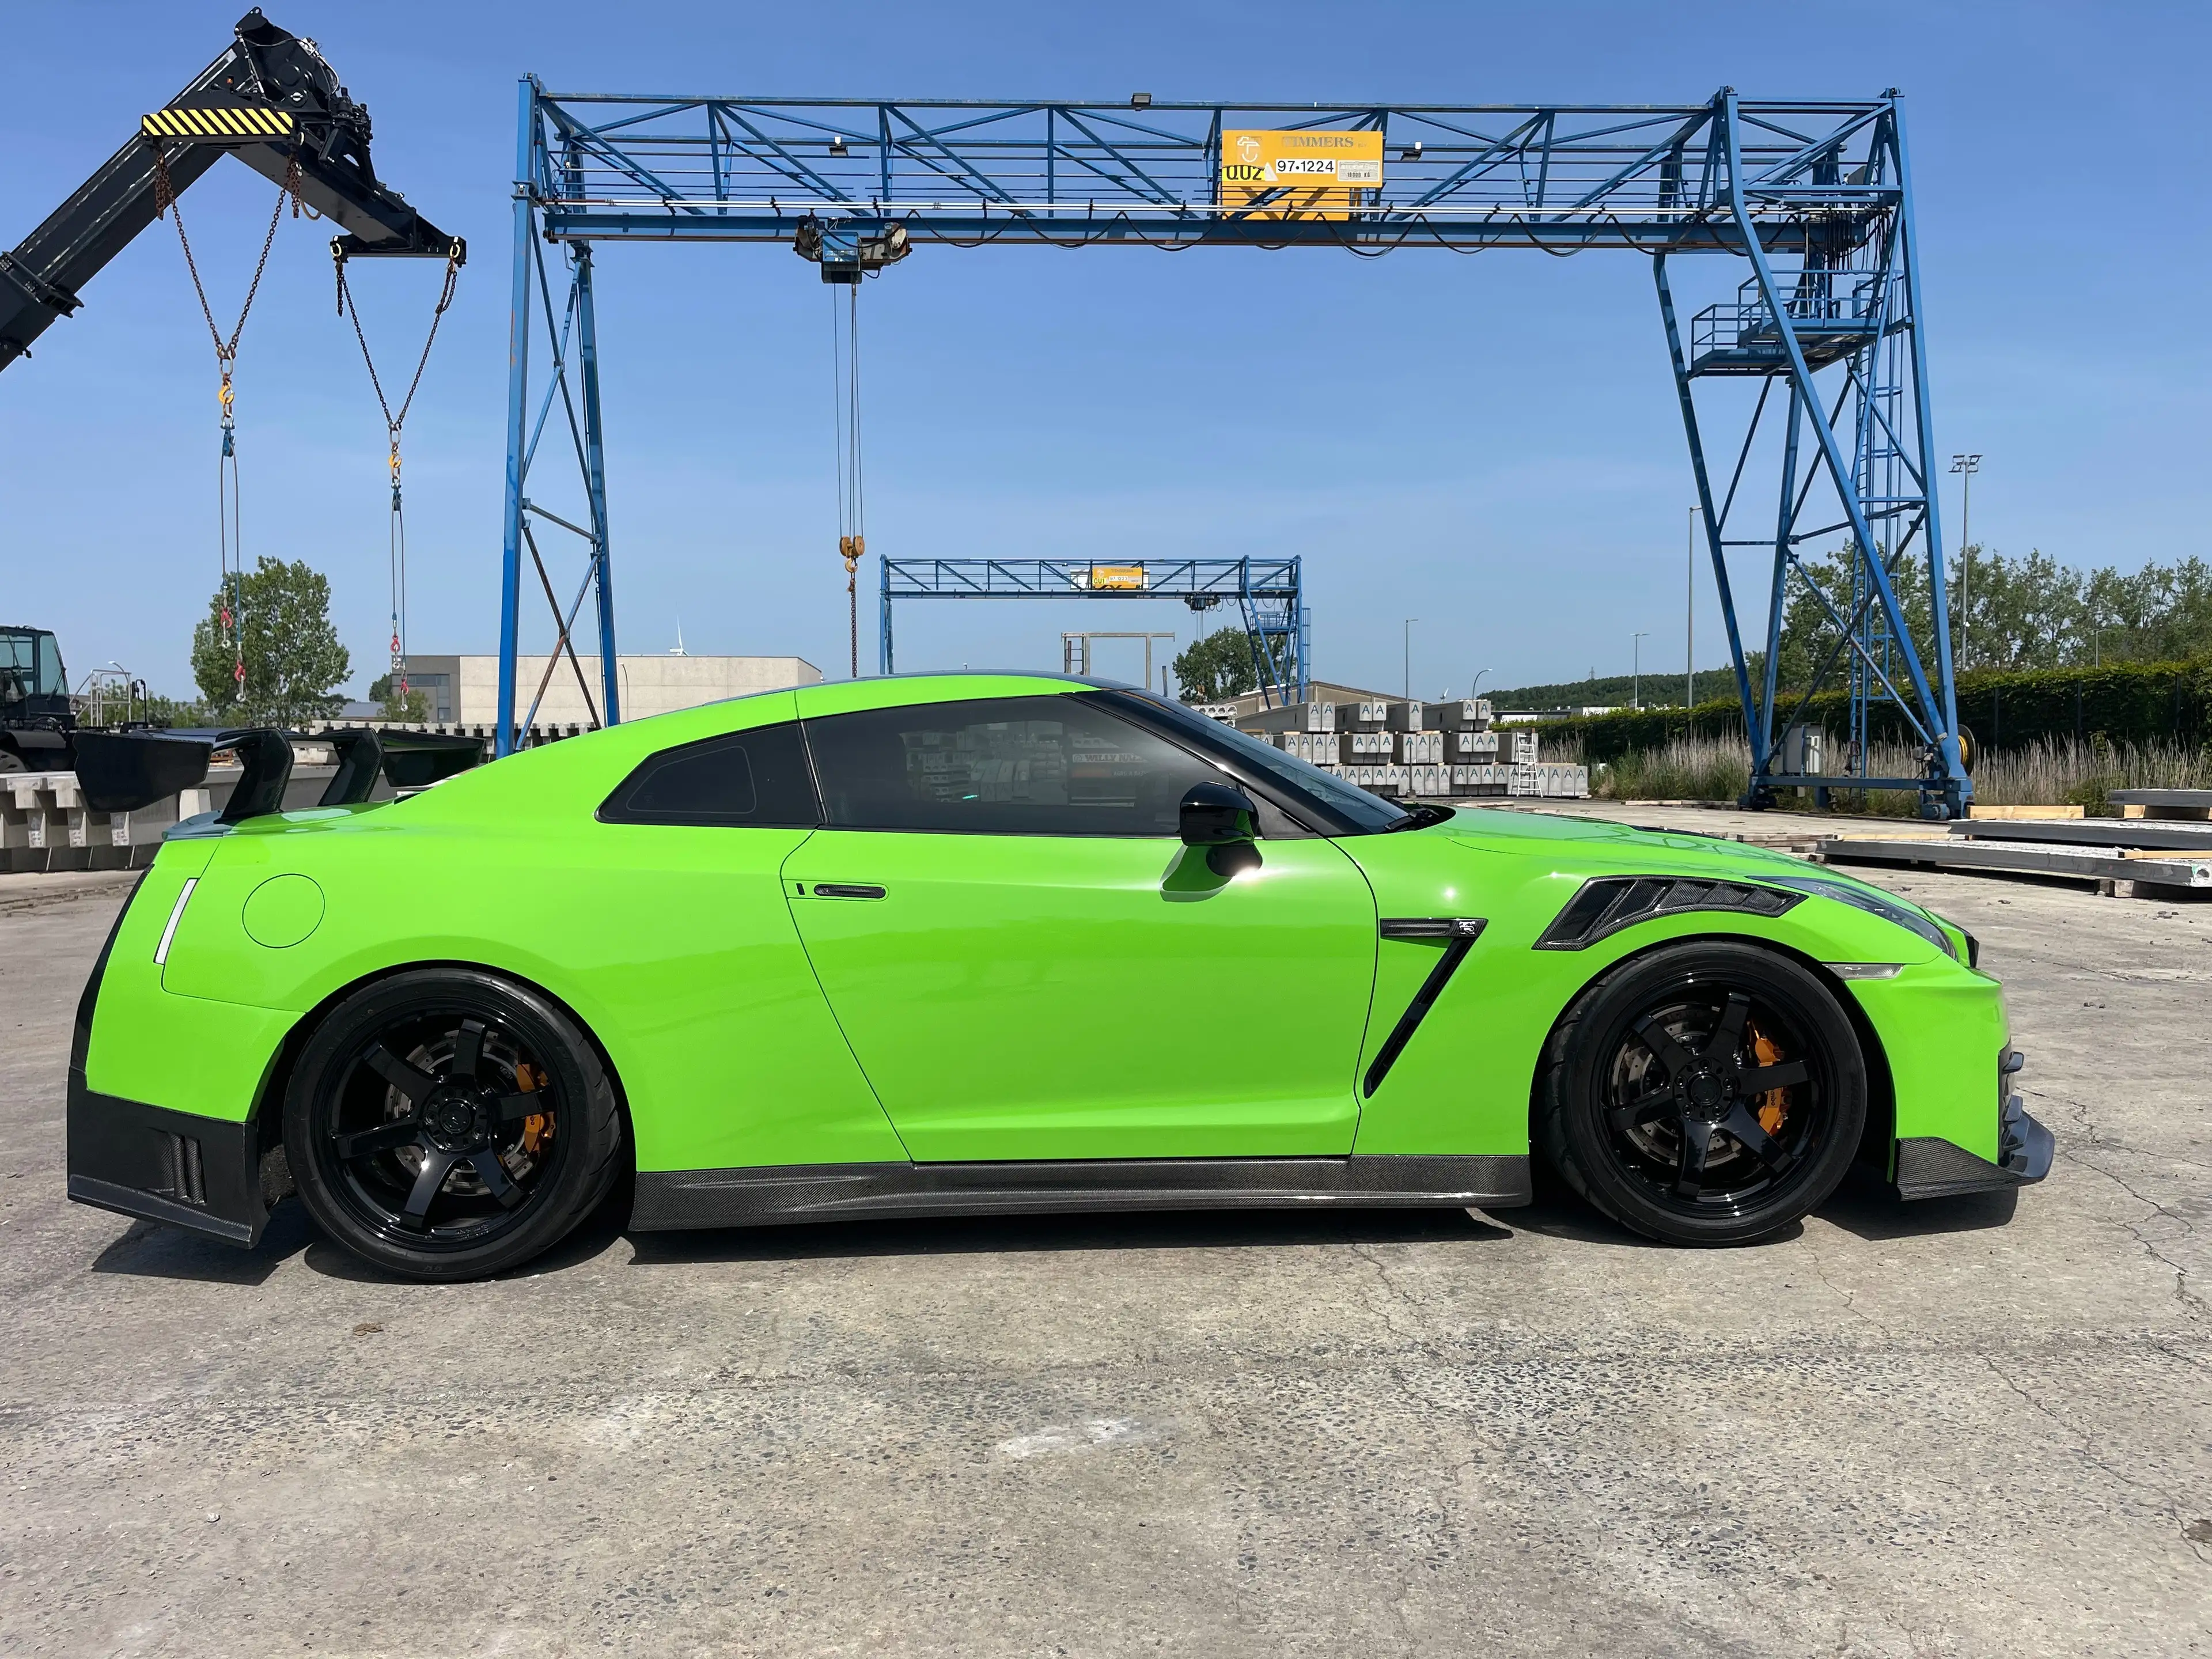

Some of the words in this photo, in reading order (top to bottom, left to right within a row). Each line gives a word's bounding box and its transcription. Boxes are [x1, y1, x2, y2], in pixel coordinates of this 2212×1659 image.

[1310, 704, 1319, 714] A
[1325, 704, 1333, 714] A
[1362, 704, 1371, 714] A
[1376, 704, 1384, 714] A
[1411, 704, 1419, 713] A
[1465, 704, 1473, 713] A
[1480, 704, 1488, 713] A
[1288, 737, 1296, 746] A
[1302, 737, 1310, 746] A
[1316, 737, 1324, 746] A
[1329, 737, 1337, 746] A
[1355, 737, 1363, 746] A
[1369, 737, 1377, 746] A
[1383, 736, 1391, 745] A
[1406, 736, 1414, 745] A
[1419, 736, 1427, 745] A
[1433, 736, 1441, 745] A
[1463, 736, 1470, 745] A
[1476, 736, 1484, 745] A
[1488, 736, 1495, 745] A
[1349, 770, 1356, 778] A
[1362, 769, 1370, 778] A
[1376, 769, 1384, 778] A
[1389, 769, 1397, 778] A
[1401, 769, 1408, 778] A
[1414, 768, 1422, 777] A
[1427, 768, 1434, 777] A
[1441, 768, 1449, 777] A
[1457, 768, 1464, 777] A
[1470, 768, 1478, 777] A
[1484, 768, 1491, 777] A
[1497, 768, 1505, 777] A
[1538, 768, 1546, 778] A
[1551, 768, 1559, 778] A
[1565, 769, 1573, 778] A
[1577, 769, 1585, 779] A
